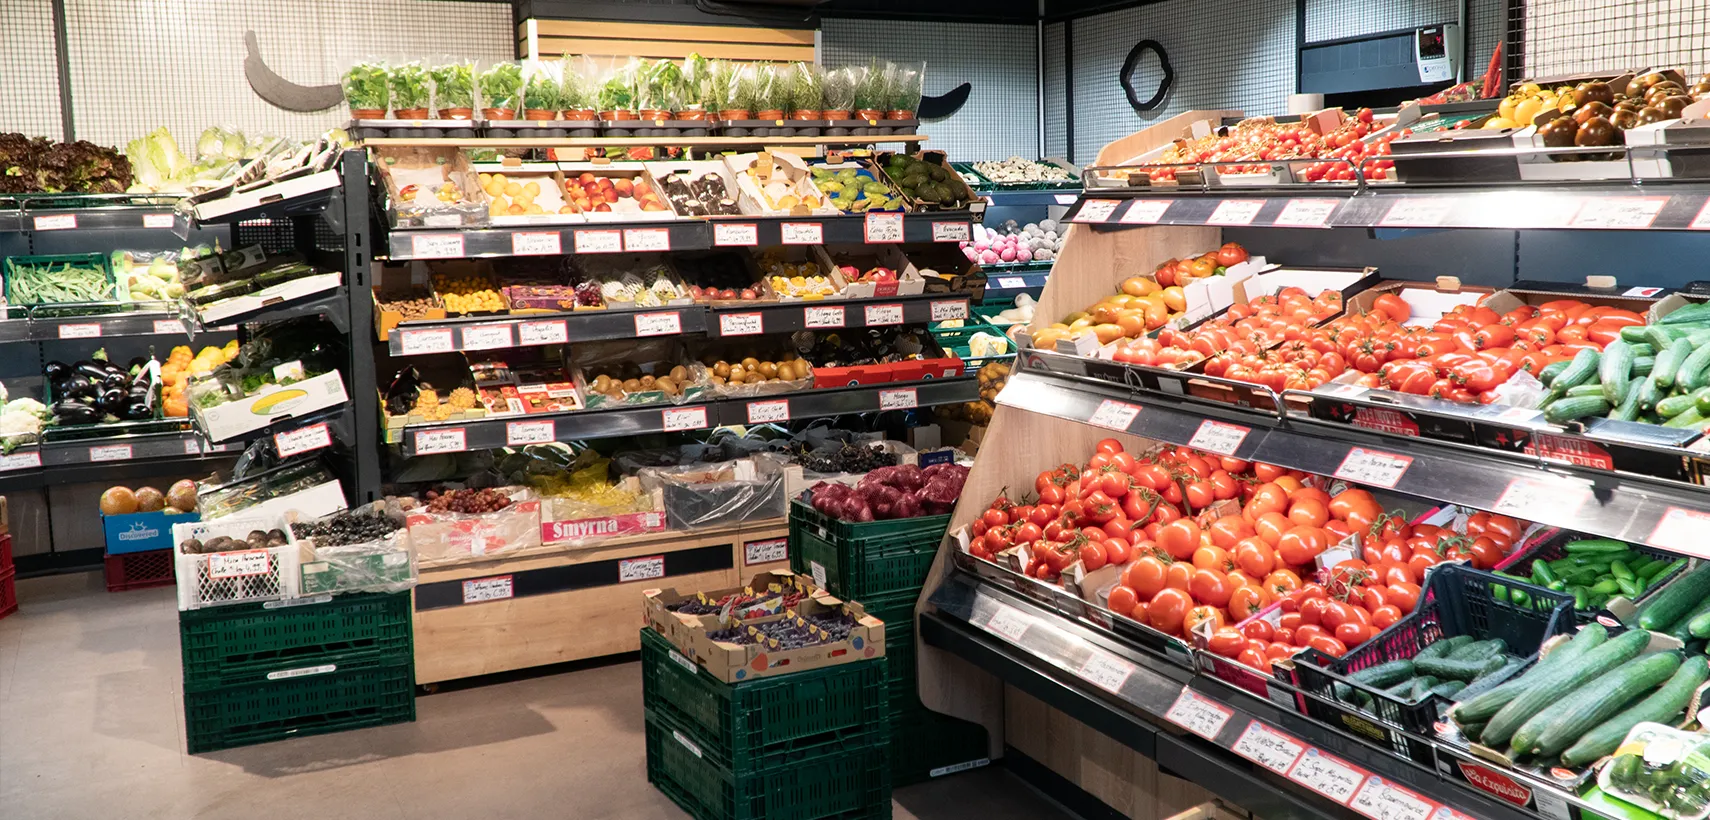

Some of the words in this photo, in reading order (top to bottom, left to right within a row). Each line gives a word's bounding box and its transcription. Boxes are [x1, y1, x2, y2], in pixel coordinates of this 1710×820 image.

[1375, 408, 1402, 426] LOVE
[1554, 435, 1589, 456] LOVE
[120, 530, 158, 540] Discovered
[553, 519, 619, 538] Smyrna
[1465, 768, 1480, 783] La
